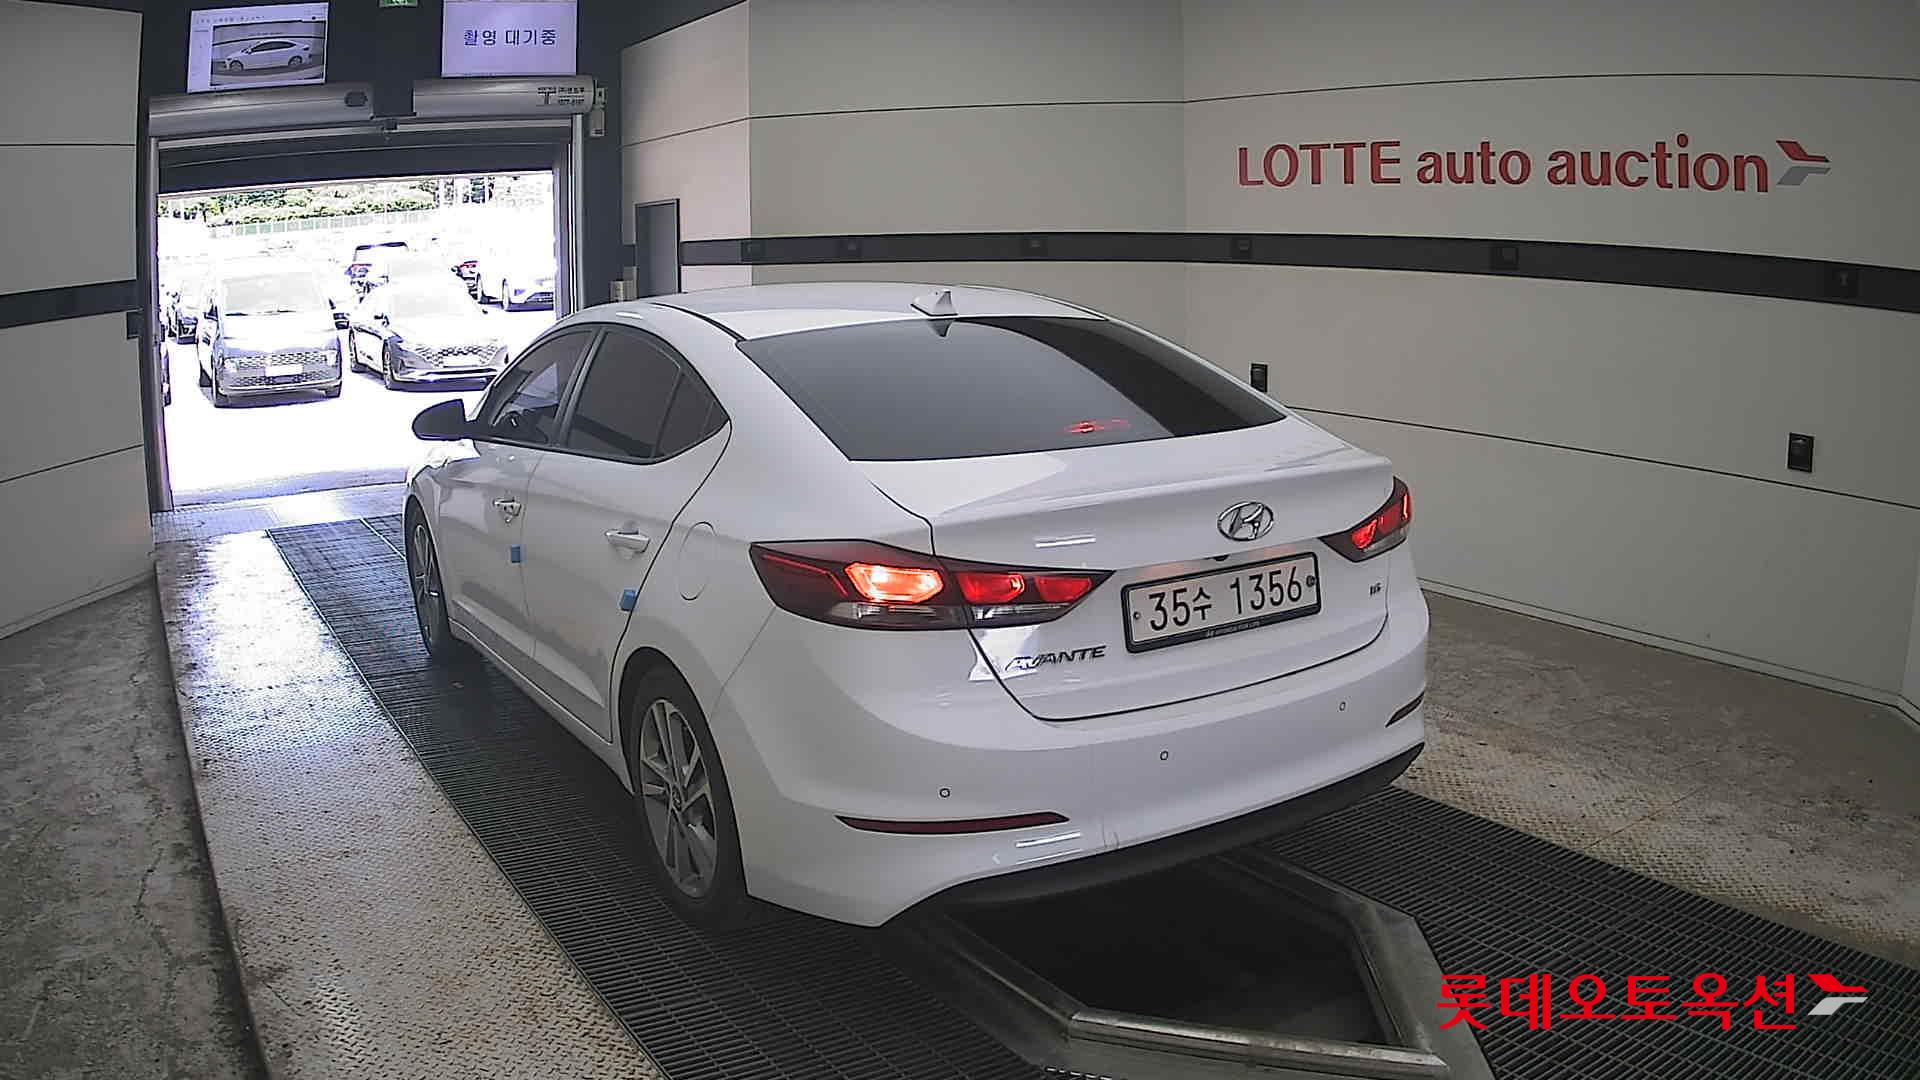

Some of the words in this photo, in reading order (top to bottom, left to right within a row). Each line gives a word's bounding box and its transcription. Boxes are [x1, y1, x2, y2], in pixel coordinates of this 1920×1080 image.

[505, 29, 556, 46] 대기중
[1238, 140, 1402, 187] LOTTE
[1417, 141, 1531, 185] auto
[1547, 134, 1768, 192] auction
[1149, 587, 1212, 631] 35수
[1230, 566, 1302, 614] 1356
[1005, 645, 1106, 671] AVANTE
